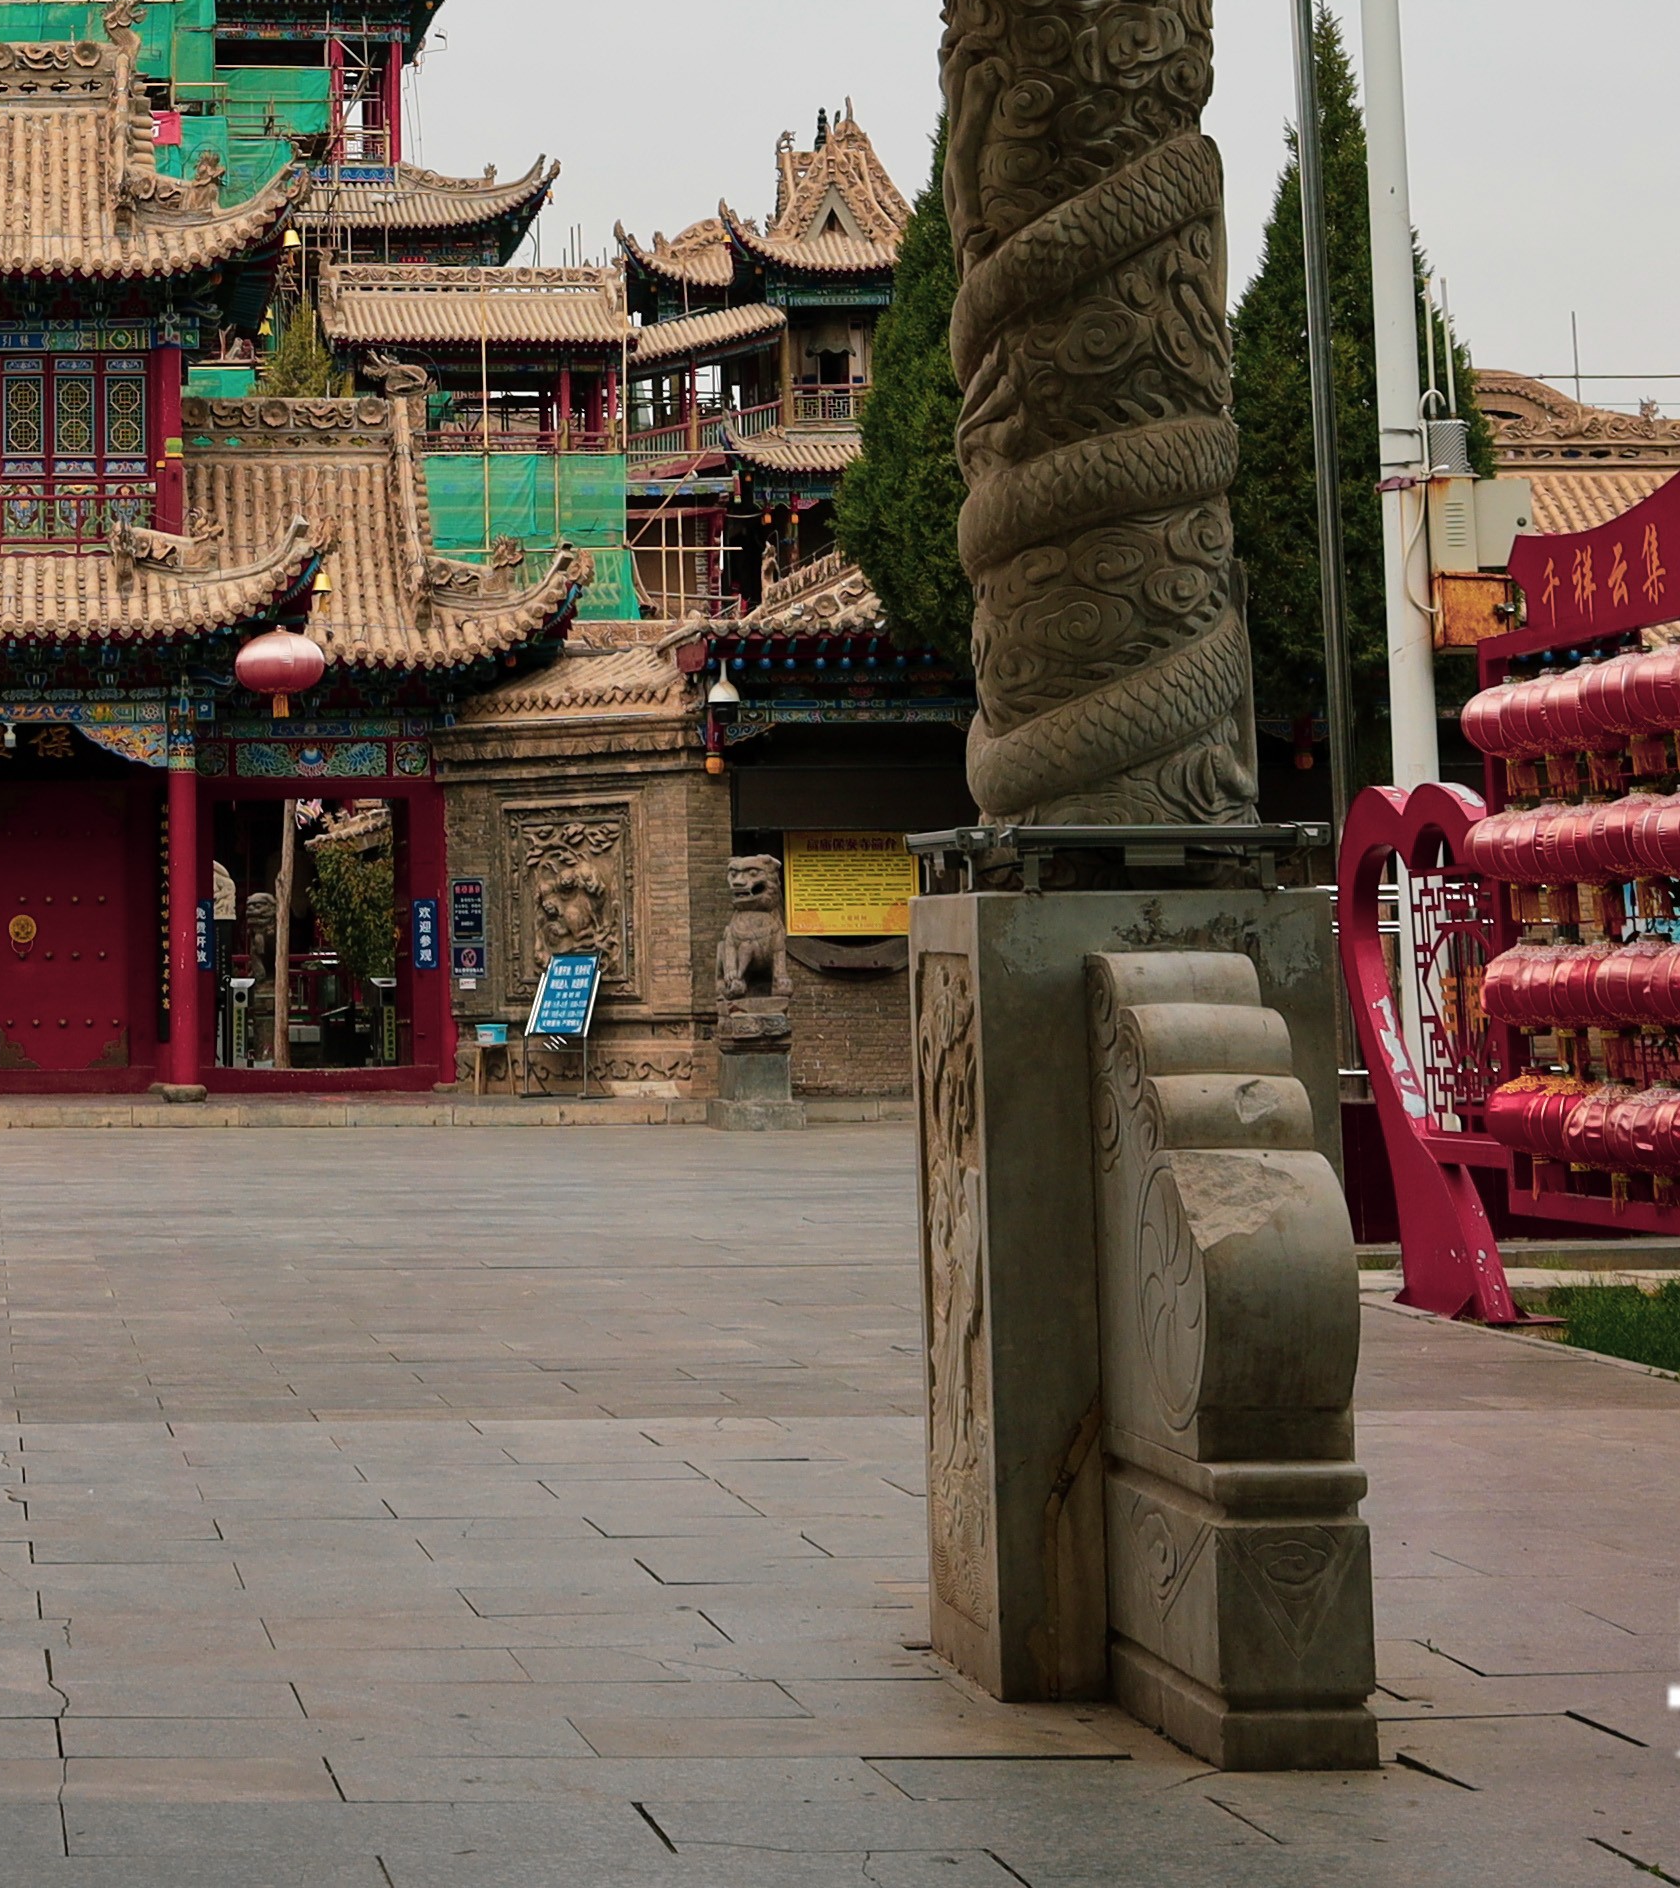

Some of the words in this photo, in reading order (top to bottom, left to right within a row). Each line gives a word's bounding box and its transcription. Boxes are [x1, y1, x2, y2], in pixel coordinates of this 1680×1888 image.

[1541, 522, 1666, 629] 千祥云集
[418, 906, 433, 962] 欢迎参观
